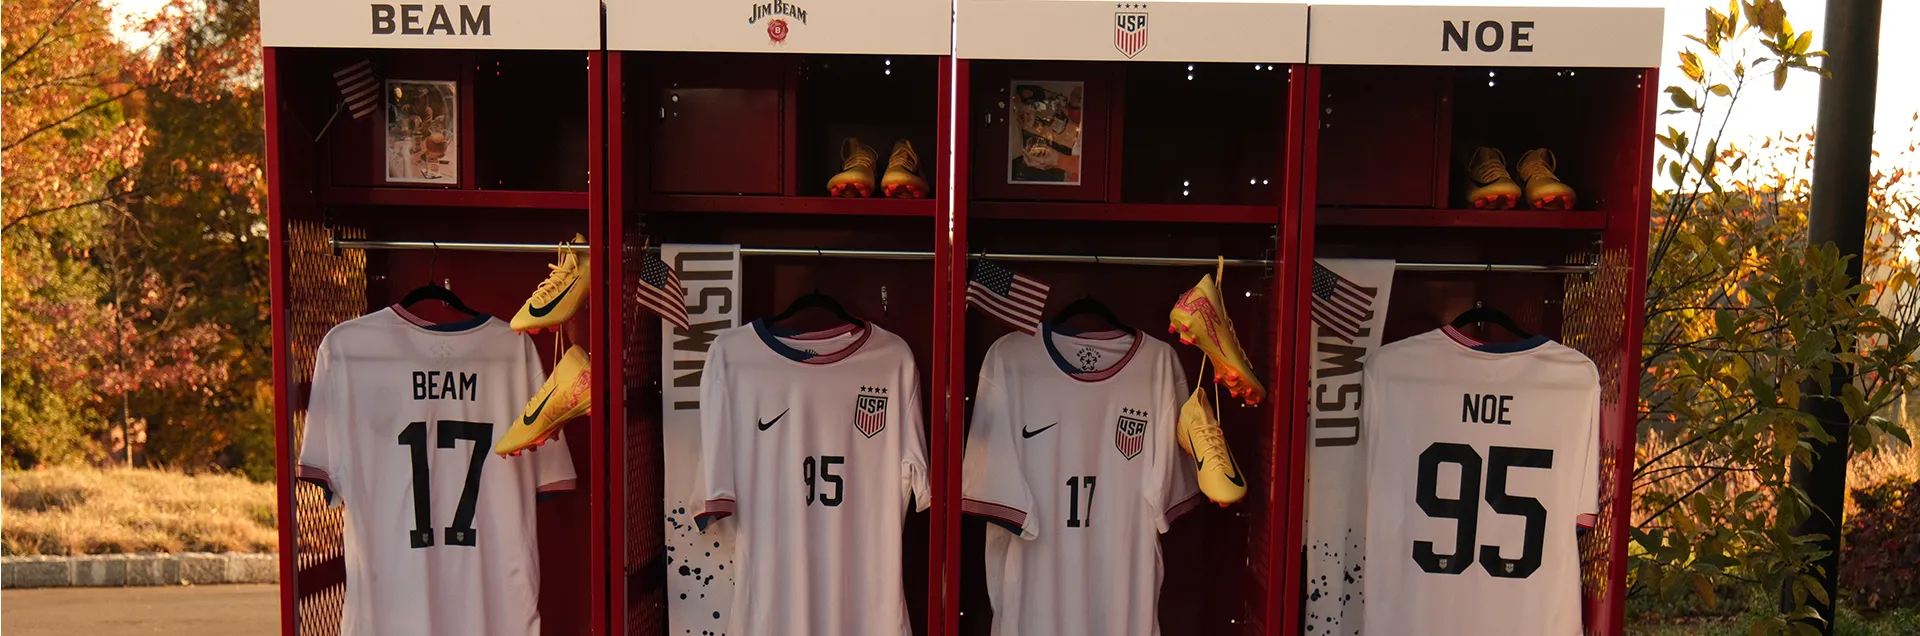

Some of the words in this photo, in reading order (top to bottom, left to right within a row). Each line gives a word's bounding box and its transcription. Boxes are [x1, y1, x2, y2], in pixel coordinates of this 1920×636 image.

[371, 4, 492, 36] BEAM
[748, 3, 772, 24] JIM
[773, 0, 808, 26] BEAM
[1117, 15, 1146, 32] USA
[1441, 20, 1535, 53] NOE
[1315, 287, 1378, 447] USW
[412, 371, 477, 401] BEAM
[860, 397, 884, 414] USA
[1462, 393, 1513, 425] NOE
[1120, 419, 1144, 436] USA
[398, 420, 493, 548] 17
[803, 455, 844, 507] 95
[1066, 476, 1096, 528] 17
[1412, 442, 1554, 579] 95
